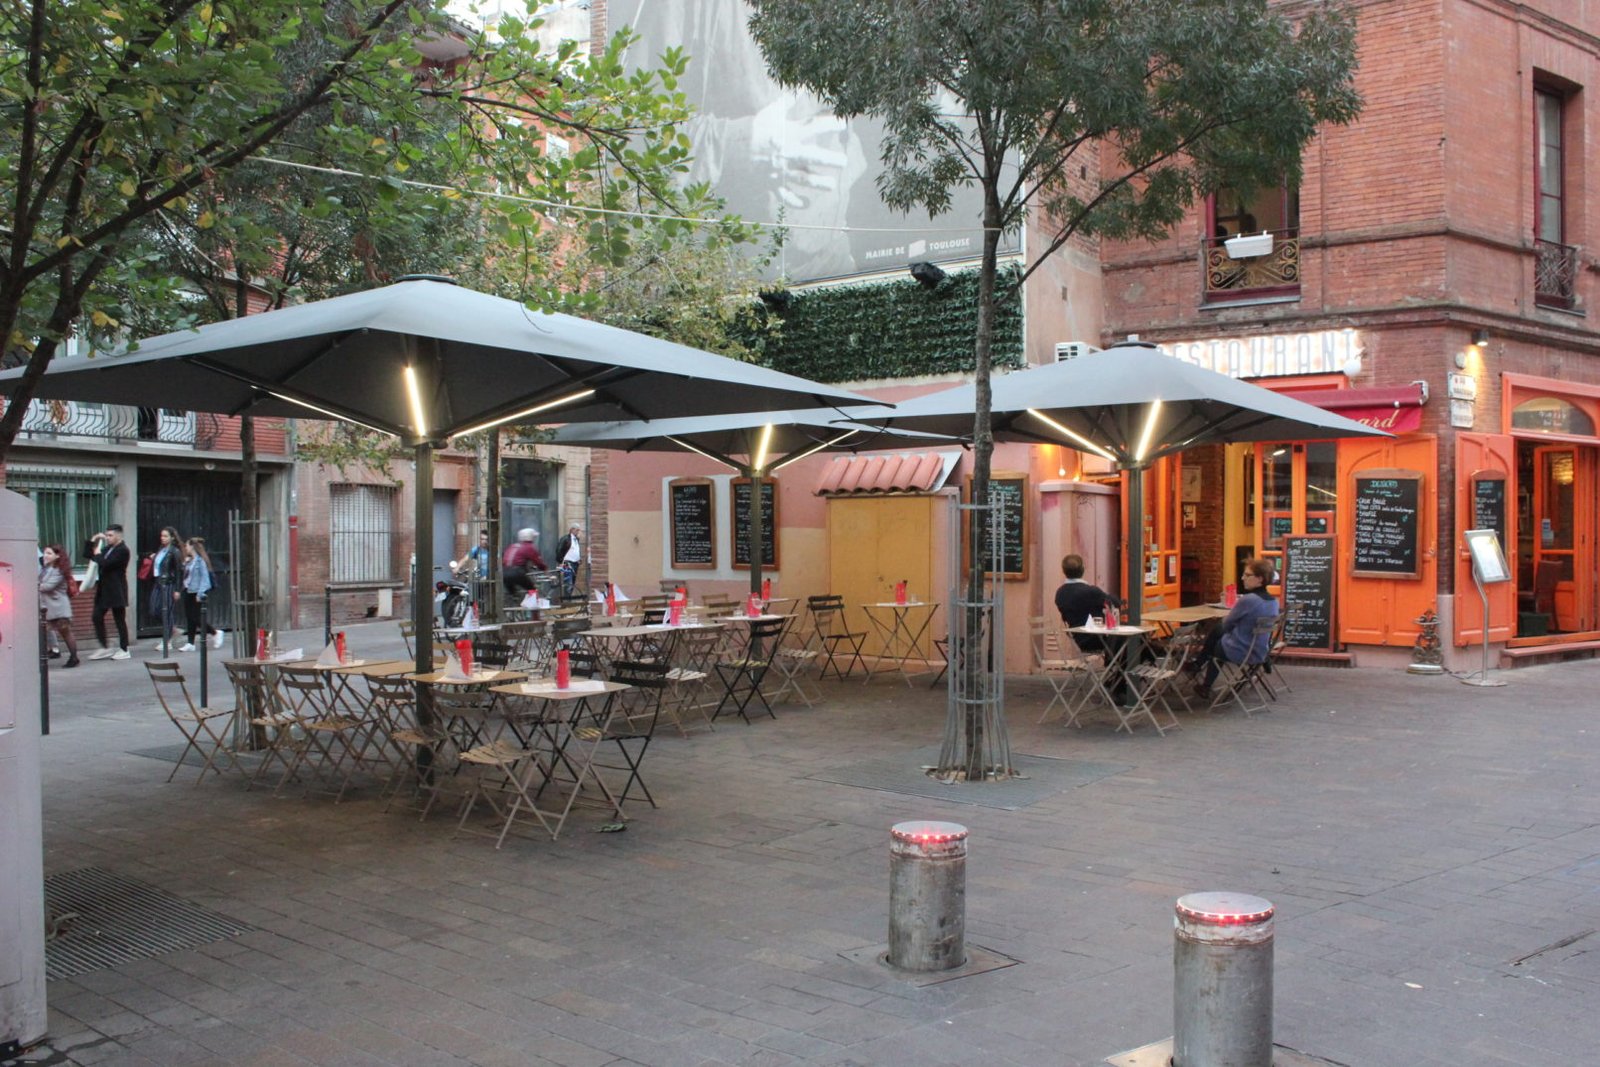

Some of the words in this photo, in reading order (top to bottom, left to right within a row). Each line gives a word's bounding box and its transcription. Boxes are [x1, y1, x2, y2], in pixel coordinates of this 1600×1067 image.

[865, 247, 893, 259] MAIRIE
[895, 246, 905, 255] DE
[929, 238, 970, 251] TOULOUSE
[1157, 330, 1355, 379] STAURANT
